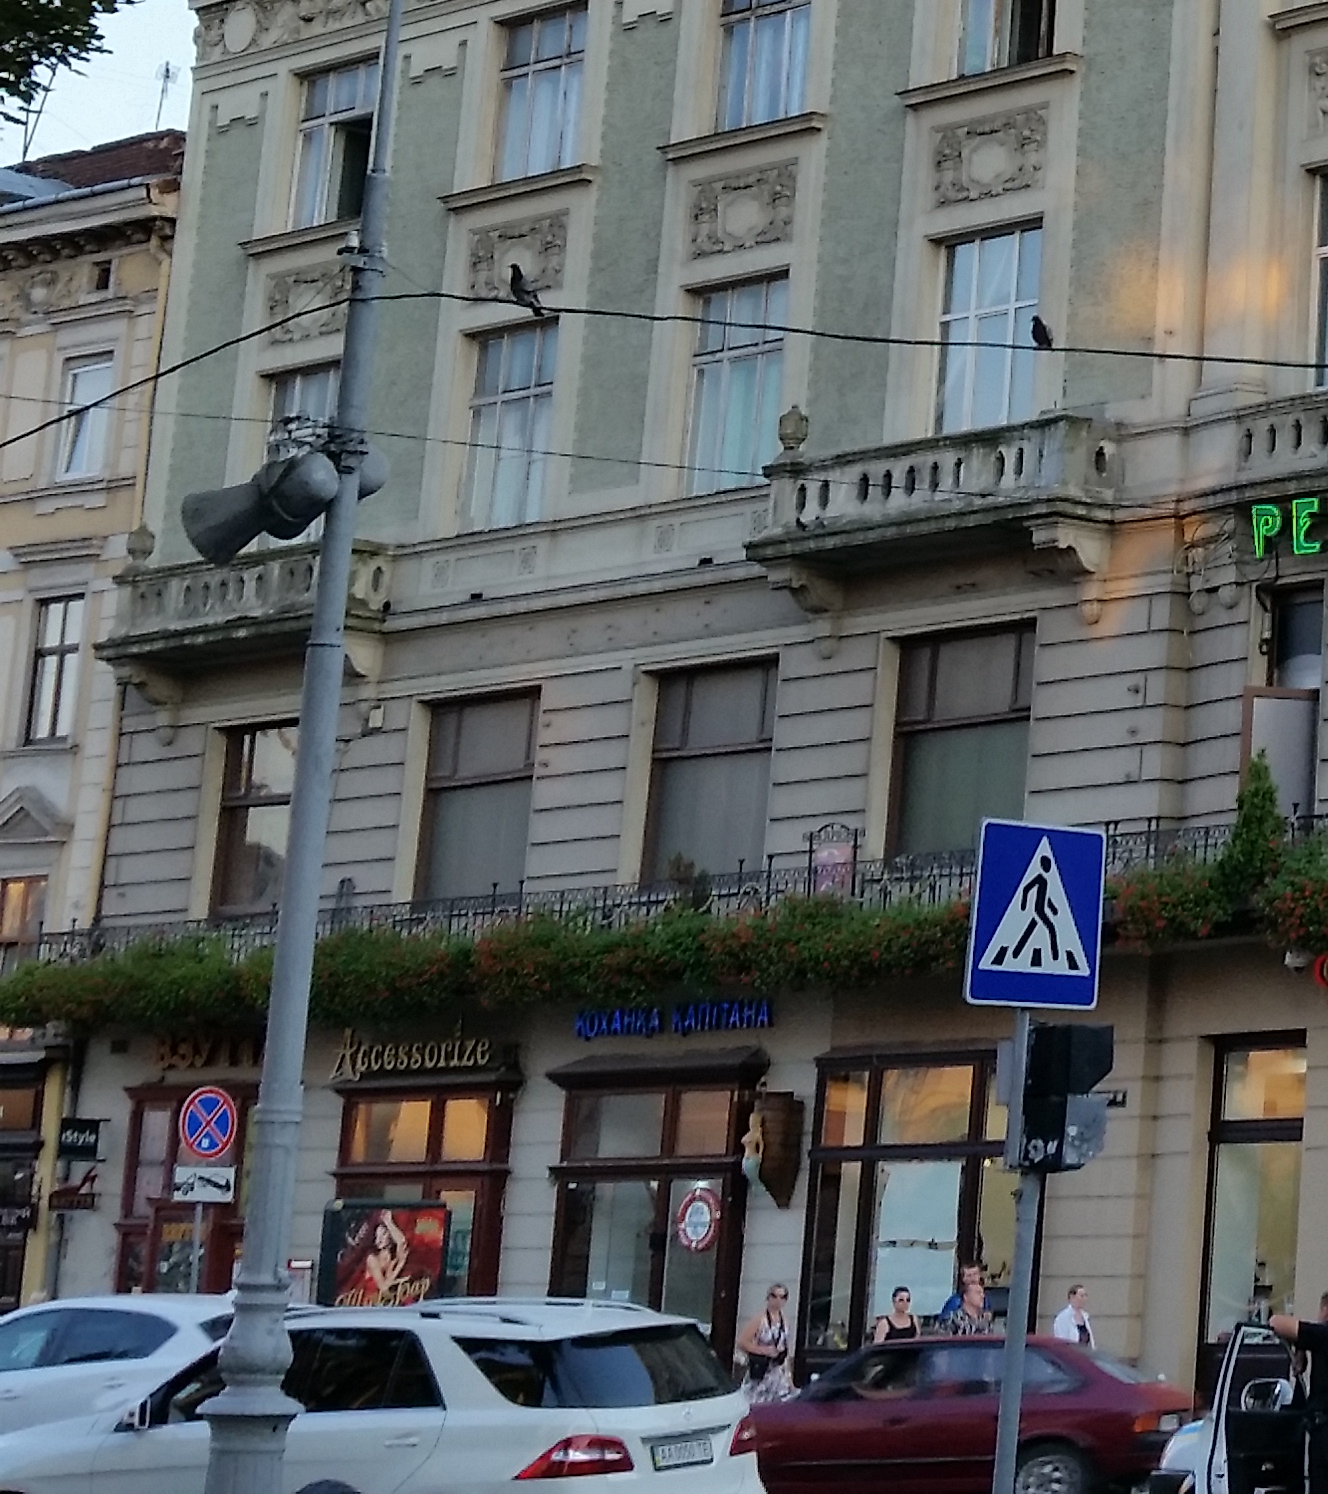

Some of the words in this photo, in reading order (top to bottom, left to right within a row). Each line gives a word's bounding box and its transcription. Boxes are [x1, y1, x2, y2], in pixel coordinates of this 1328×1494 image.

[574, 1008, 660, 1038] КОХАНКА
[671, 1000, 770, 1033] КАПІТАНА
[330, 1020, 491, 1082] Accessorize
[61, 1128, 97, 1146] iStyle
